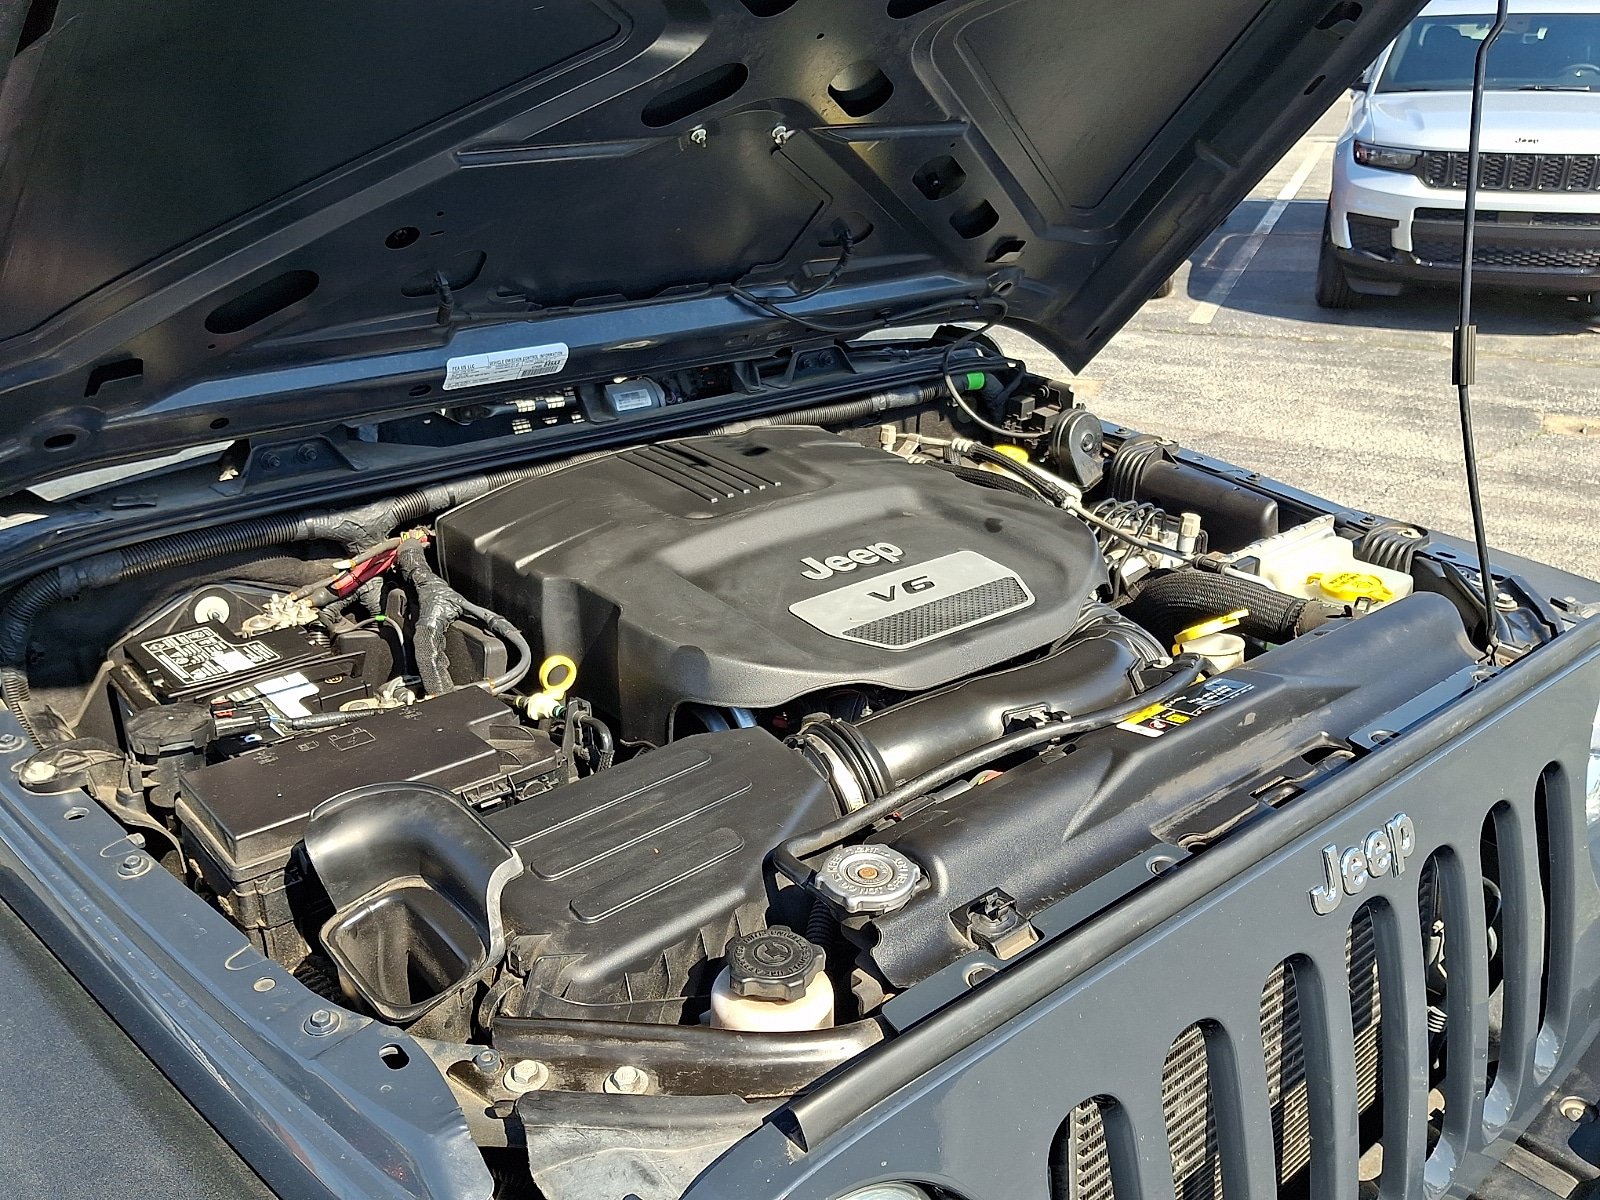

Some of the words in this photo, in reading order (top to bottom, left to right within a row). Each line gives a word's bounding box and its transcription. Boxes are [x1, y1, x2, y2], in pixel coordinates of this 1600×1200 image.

[801, 542, 904, 581] Jeep
[867, 575, 936, 603] V6
[1308, 812, 1416, 916] Jeep
